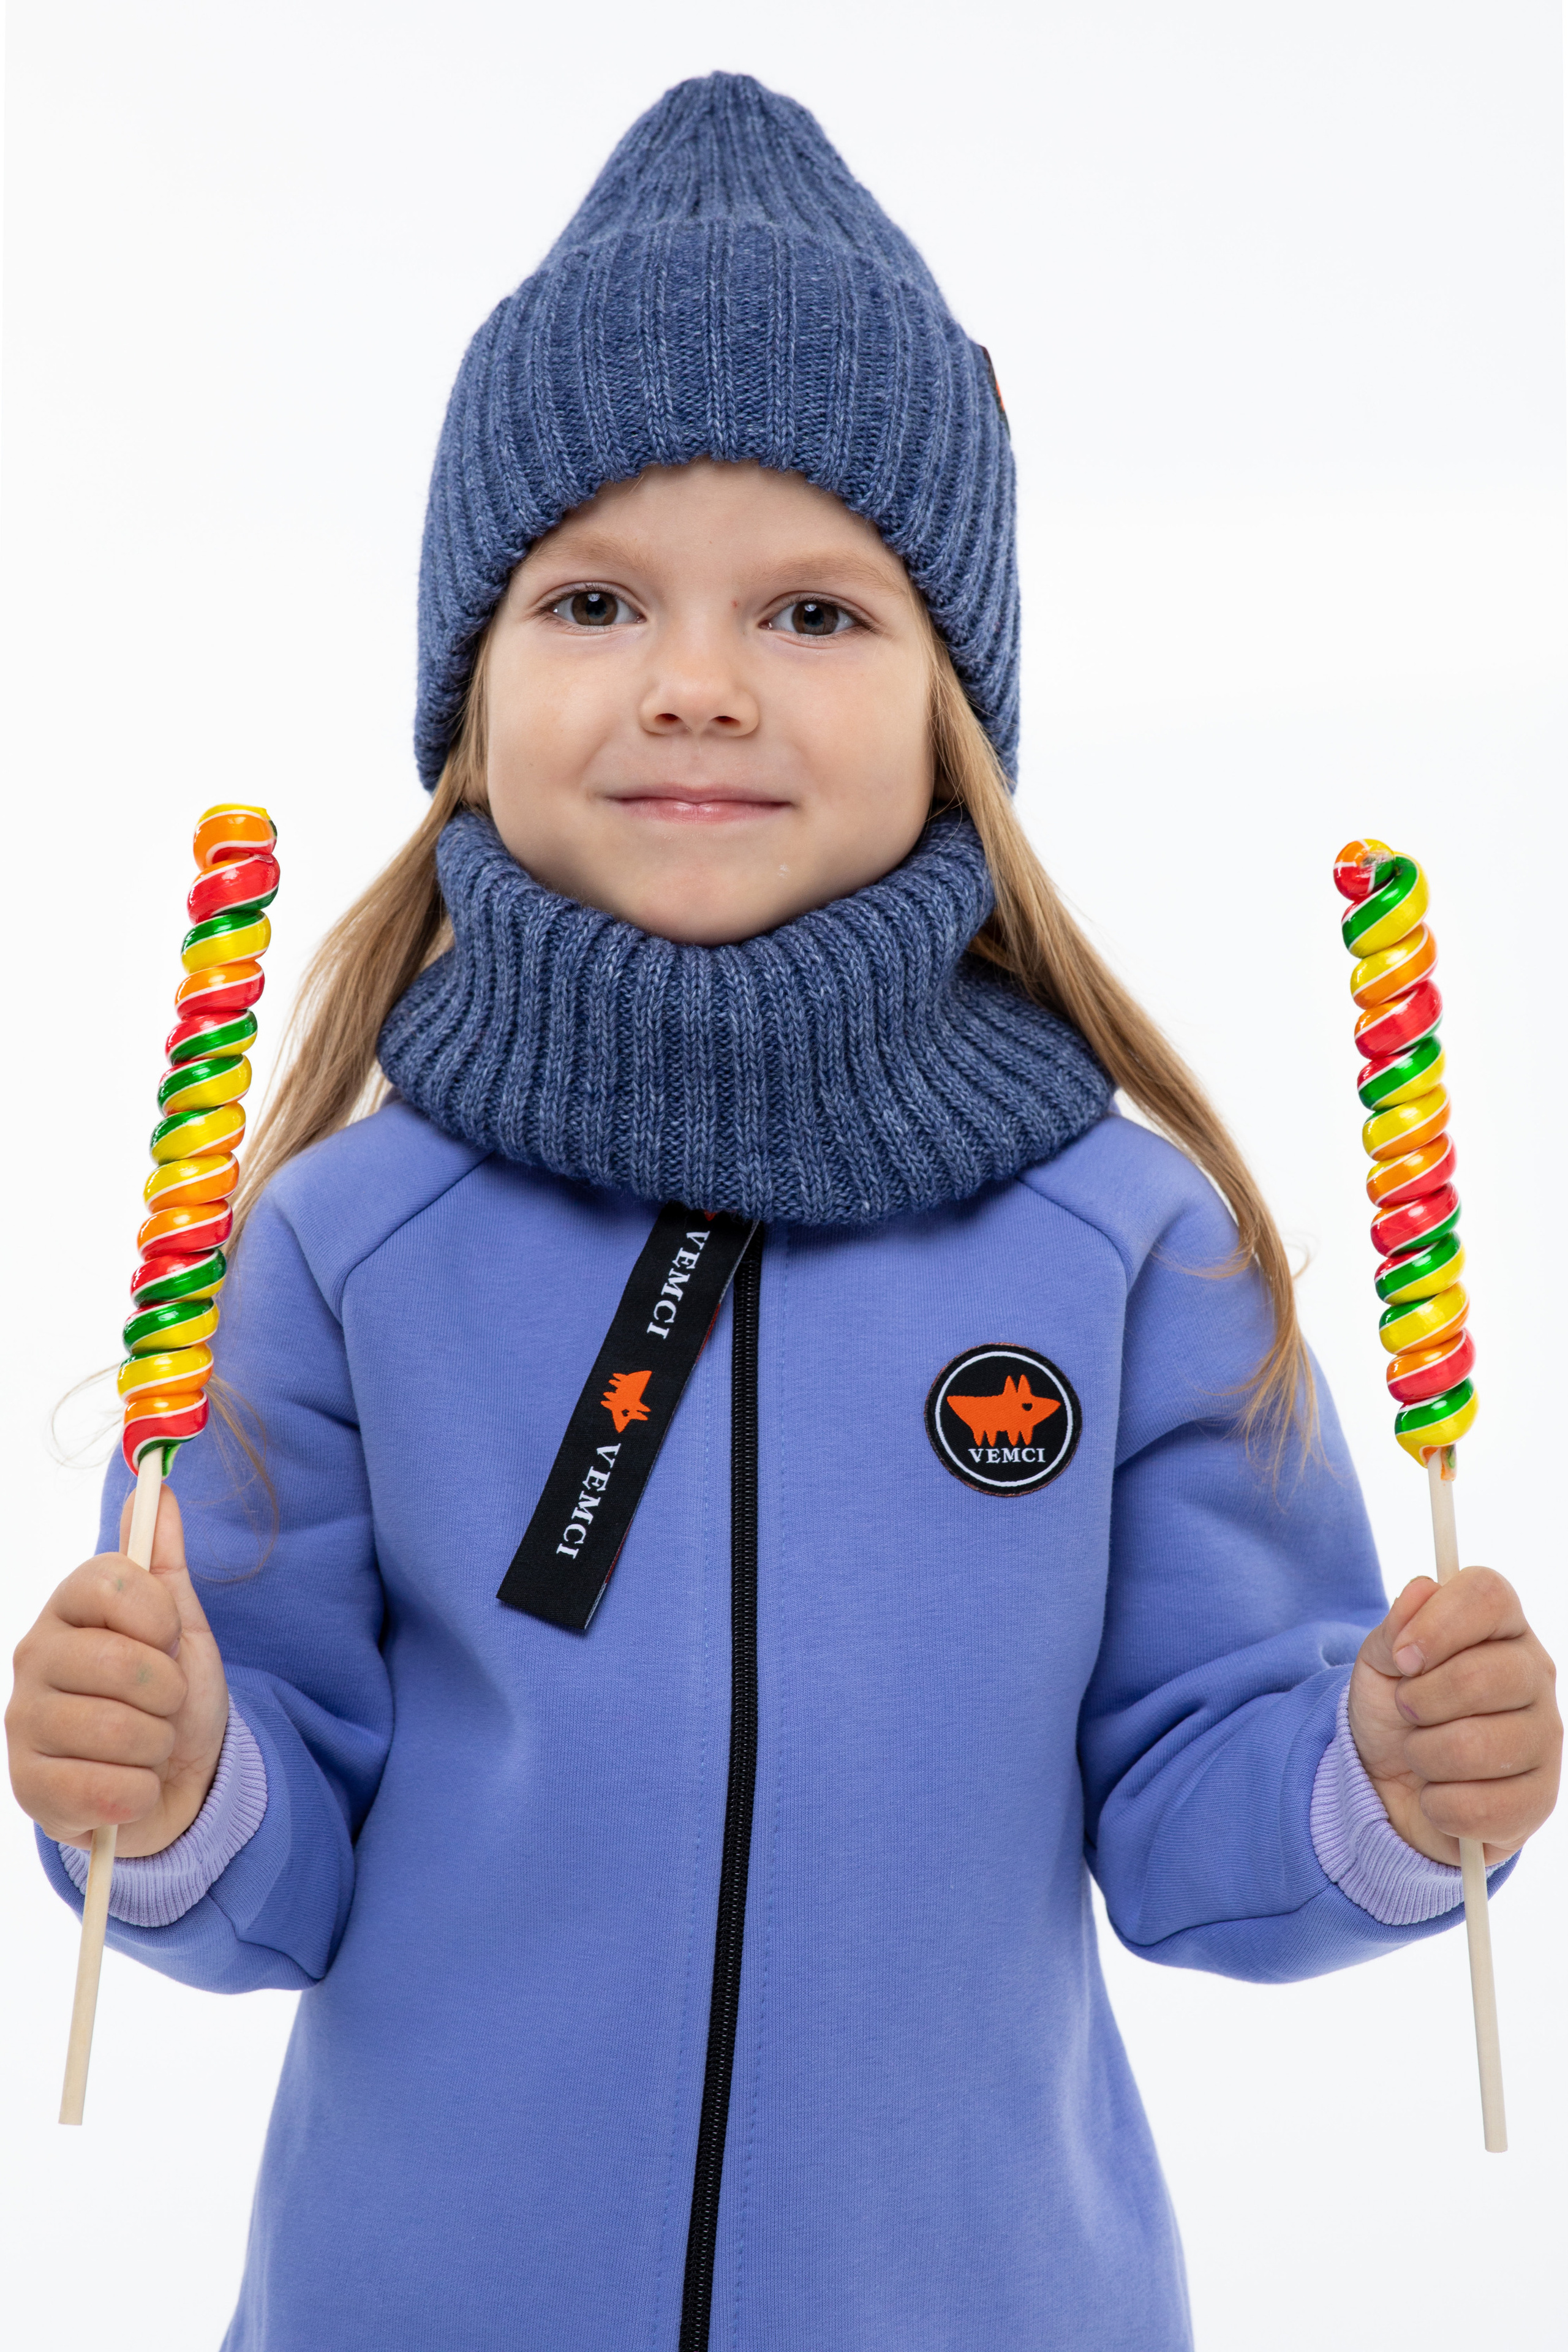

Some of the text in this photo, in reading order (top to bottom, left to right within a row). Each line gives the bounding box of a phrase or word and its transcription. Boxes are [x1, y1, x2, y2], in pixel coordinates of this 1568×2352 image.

[647, 1231, 710, 1340] VEMCI
[557, 1443, 620, 1559] VEMCI
[968, 1447, 1046, 1463] VEMCI
